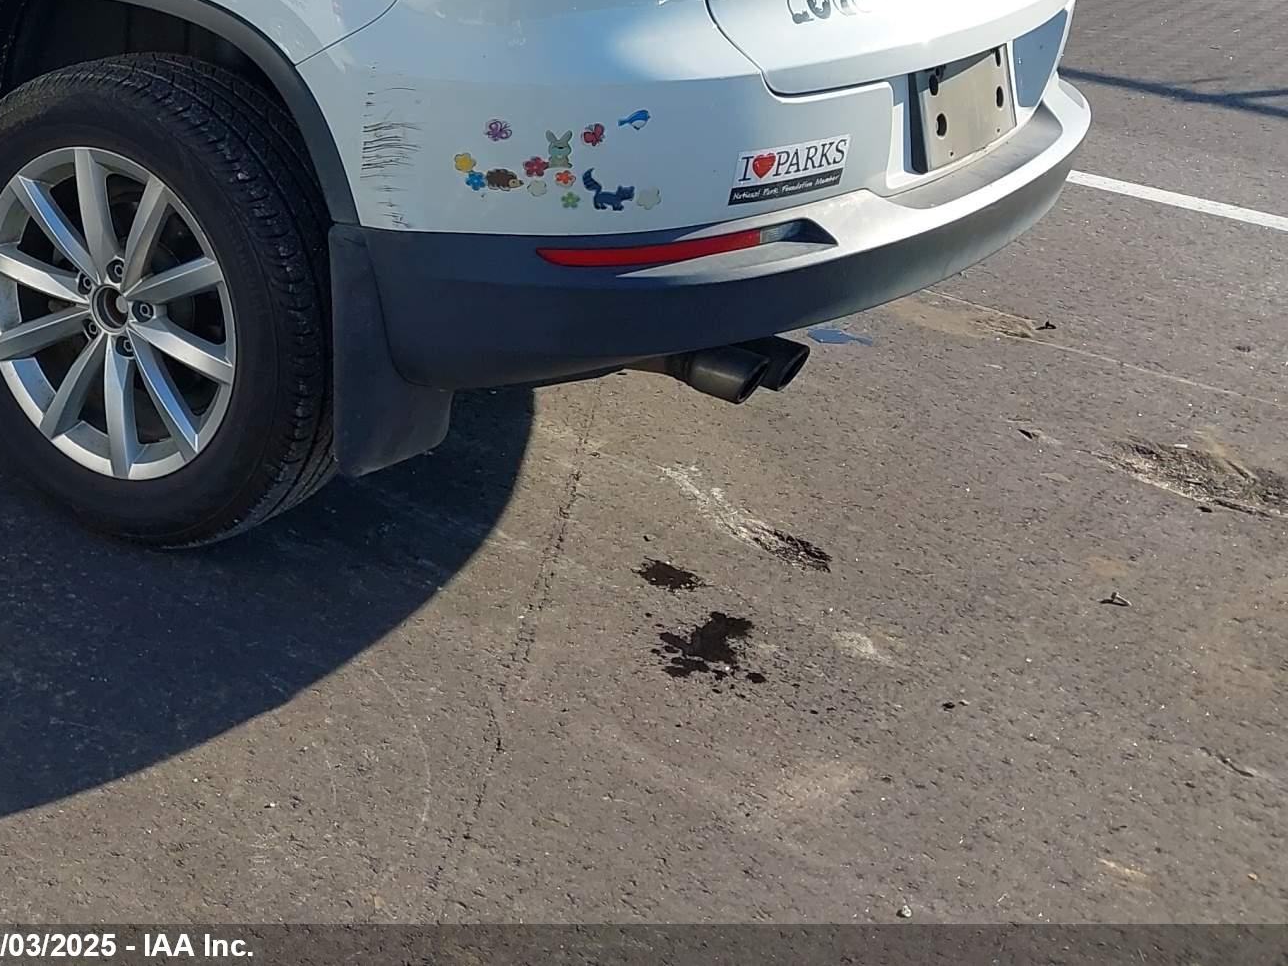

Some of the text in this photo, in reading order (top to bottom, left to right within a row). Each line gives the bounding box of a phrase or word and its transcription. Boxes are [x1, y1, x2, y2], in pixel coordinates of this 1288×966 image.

[739, 139, 848, 182] I PARKS
[733, 190, 761, 200] National
[782, 181, 813, 193] Foundation
